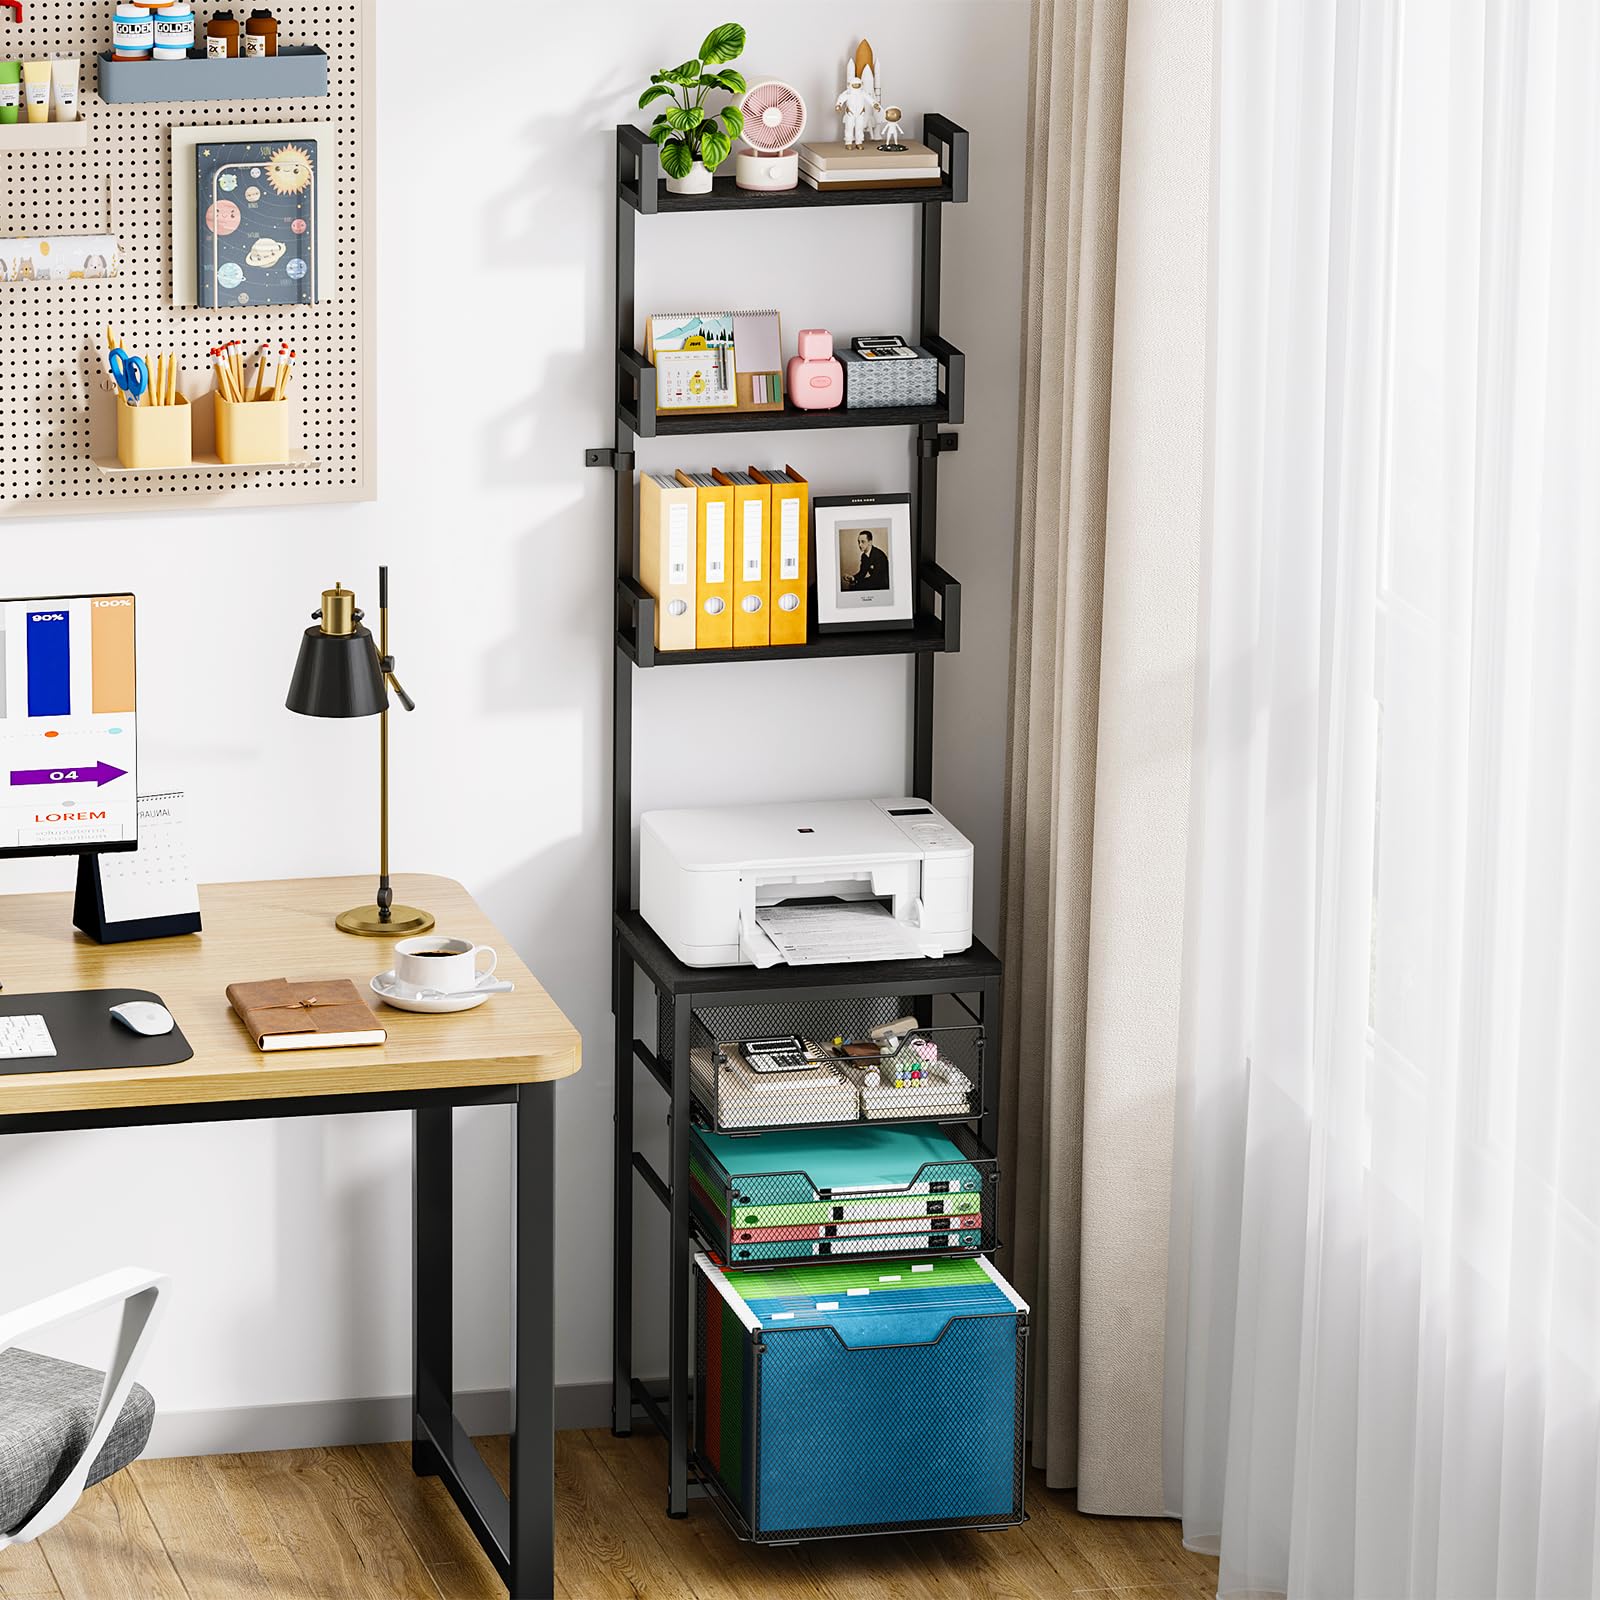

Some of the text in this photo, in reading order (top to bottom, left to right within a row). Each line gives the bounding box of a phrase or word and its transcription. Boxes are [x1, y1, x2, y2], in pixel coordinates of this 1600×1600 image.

[116, 23, 152, 34] GOLDEN
[157, 22, 193, 33] GOLDEN
[208, 44, 218, 53] 2X
[247, 43, 257, 51] 2X
[93, 599, 131, 608] 100%
[32, 614, 64, 622] 90%
[49, 770, 79, 781] 04
[35, 811, 106, 823] LOREM
